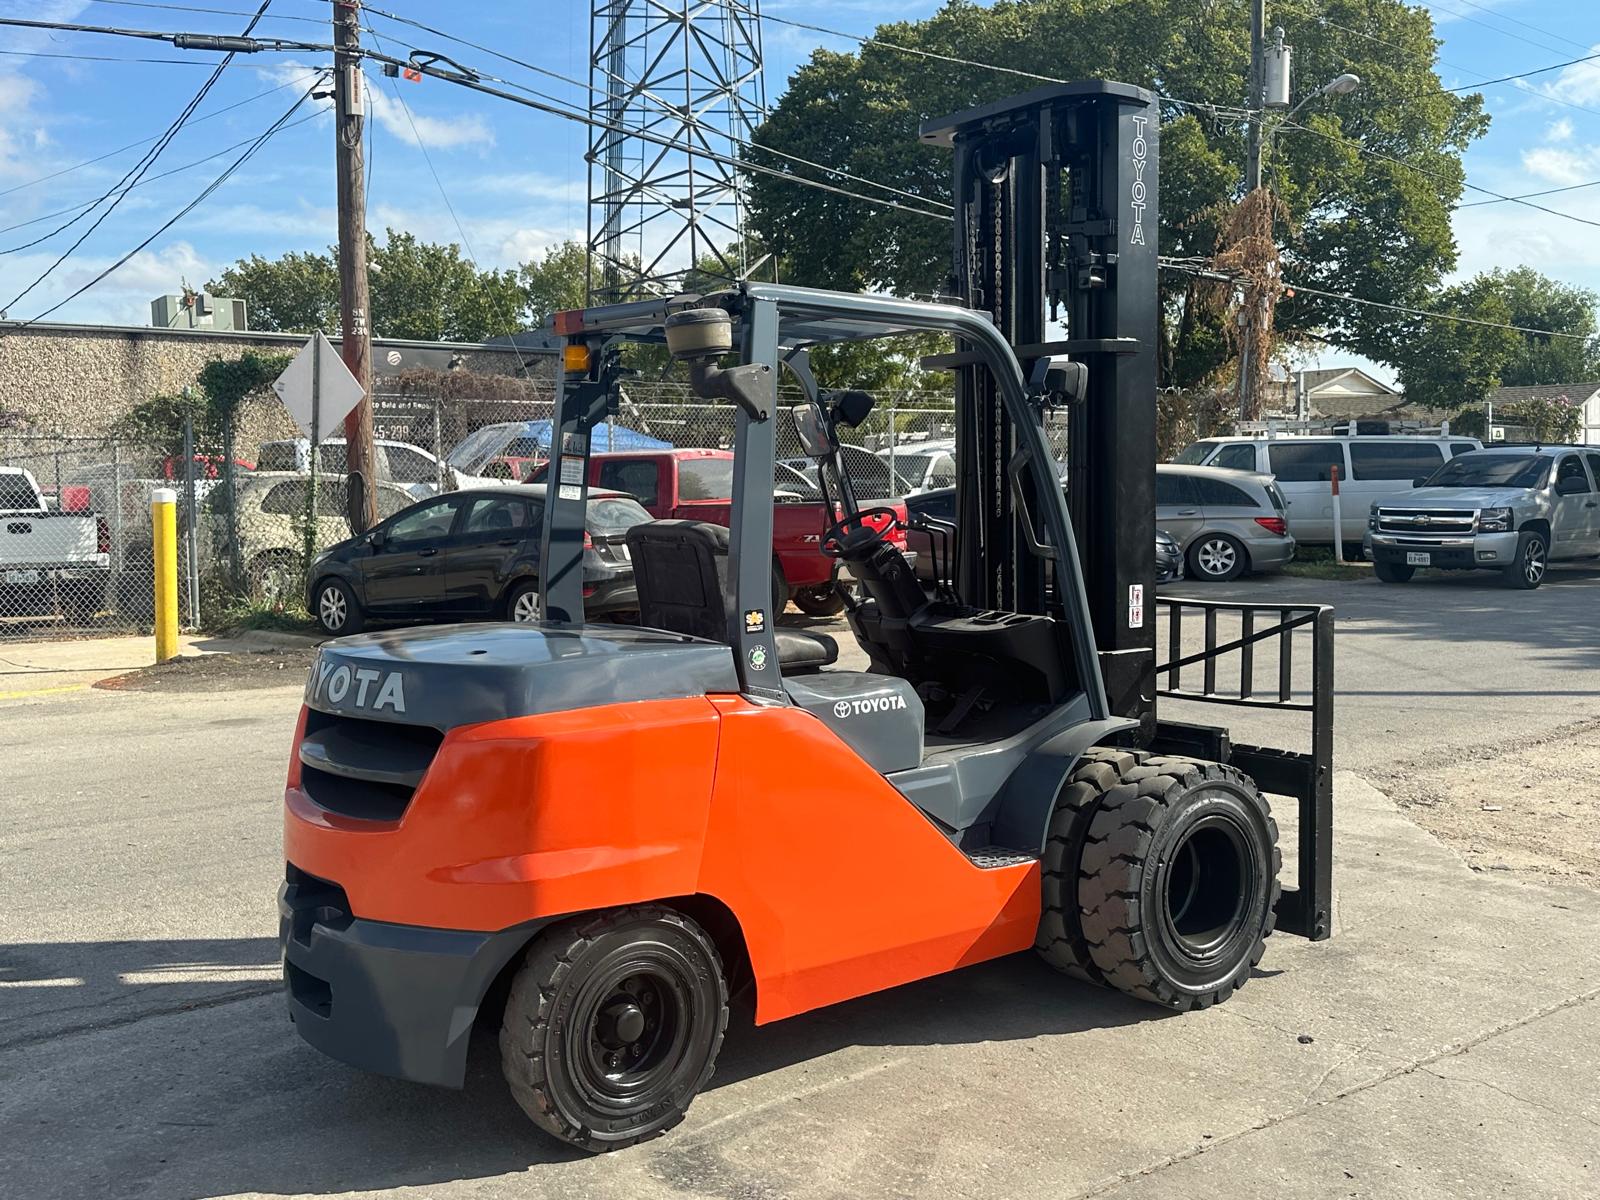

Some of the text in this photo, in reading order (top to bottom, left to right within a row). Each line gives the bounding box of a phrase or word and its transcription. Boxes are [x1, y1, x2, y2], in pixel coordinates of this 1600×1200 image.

[1130, 115, 1148, 246] TOYOTA
[398, 401, 411, 409] and
[851, 695, 907, 715] TOYOTA
